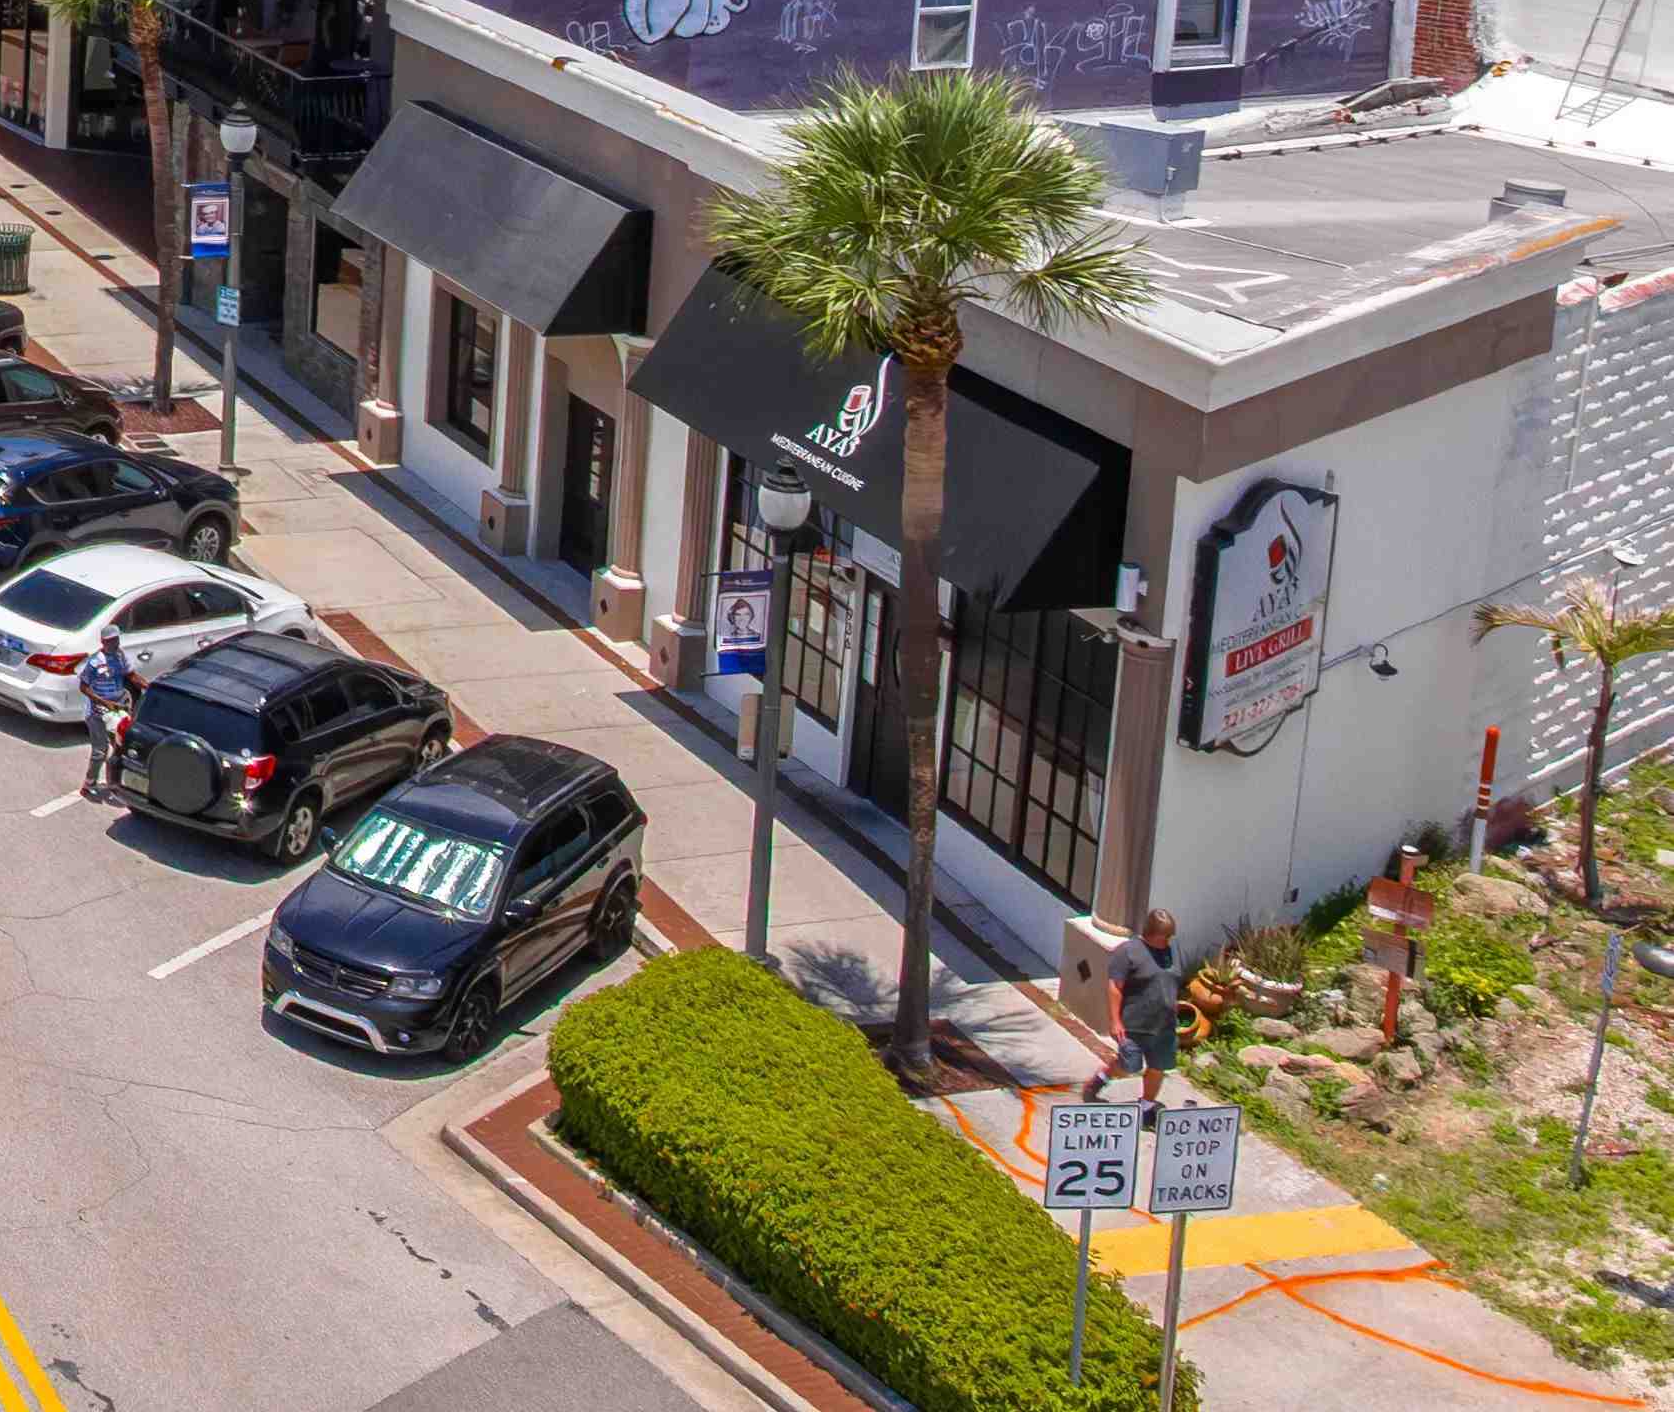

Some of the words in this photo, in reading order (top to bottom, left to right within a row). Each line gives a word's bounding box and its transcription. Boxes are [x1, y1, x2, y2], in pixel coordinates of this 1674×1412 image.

[1235, 640, 1265, 672] LIVE
[1267, 624, 1303, 656] GRILL
[1058, 1113, 1133, 1129] SPEED
[1164, 1120, 1191, 1136] DO
[1198, 1117, 1235, 1134] NOT
[1064, 1134, 1123, 1150] LIMIT
[1172, 1140, 1221, 1158] STOP
[1055, 1159, 1126, 1197] 25
[1181, 1164, 1208, 1180] ON
[1156, 1183, 1228, 1203] TRACKS
